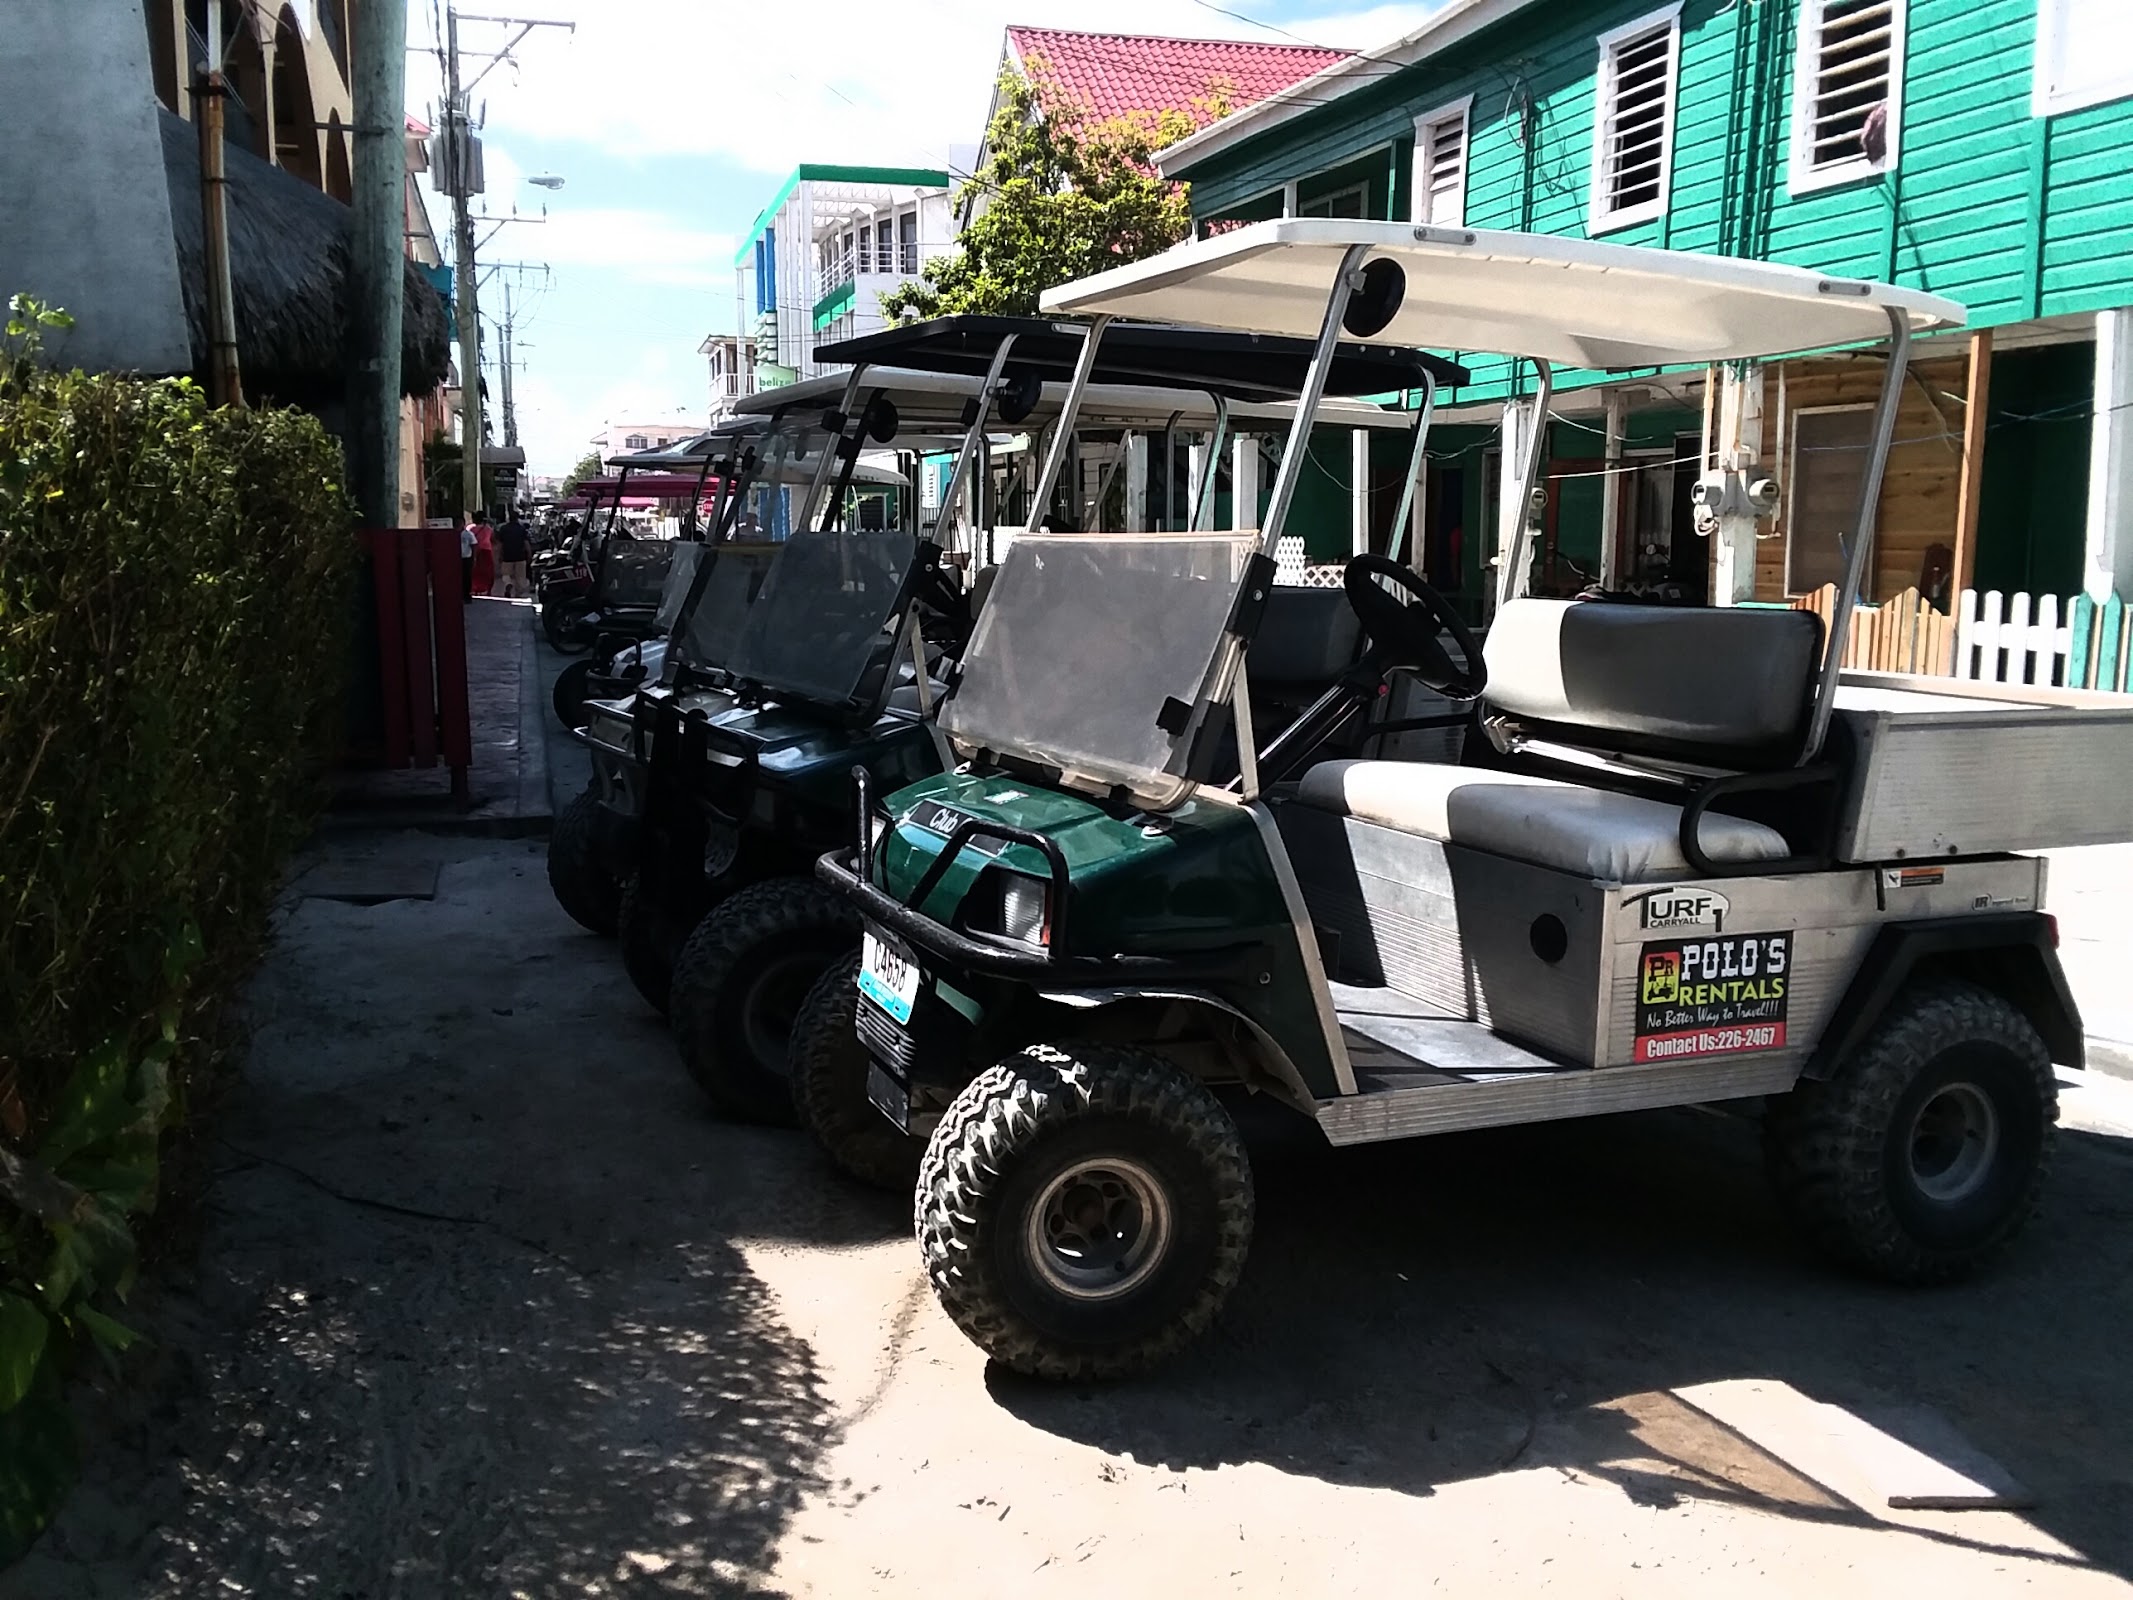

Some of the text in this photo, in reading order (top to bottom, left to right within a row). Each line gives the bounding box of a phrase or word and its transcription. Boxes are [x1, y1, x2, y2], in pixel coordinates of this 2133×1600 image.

[758, 376, 792, 387] belize
[929, 808, 960, 833] Club
[1620, 887, 1713, 929] TURF
[1650, 917, 1701, 928] CARRYALL
[1681, 937, 1787, 981] POLO'S
[1679, 977, 1785, 1007] RENTALS
[1646, 1000, 1780, 1029] No Better Way to Travel!!!
[1646, 1035, 1697, 1058] Contact
